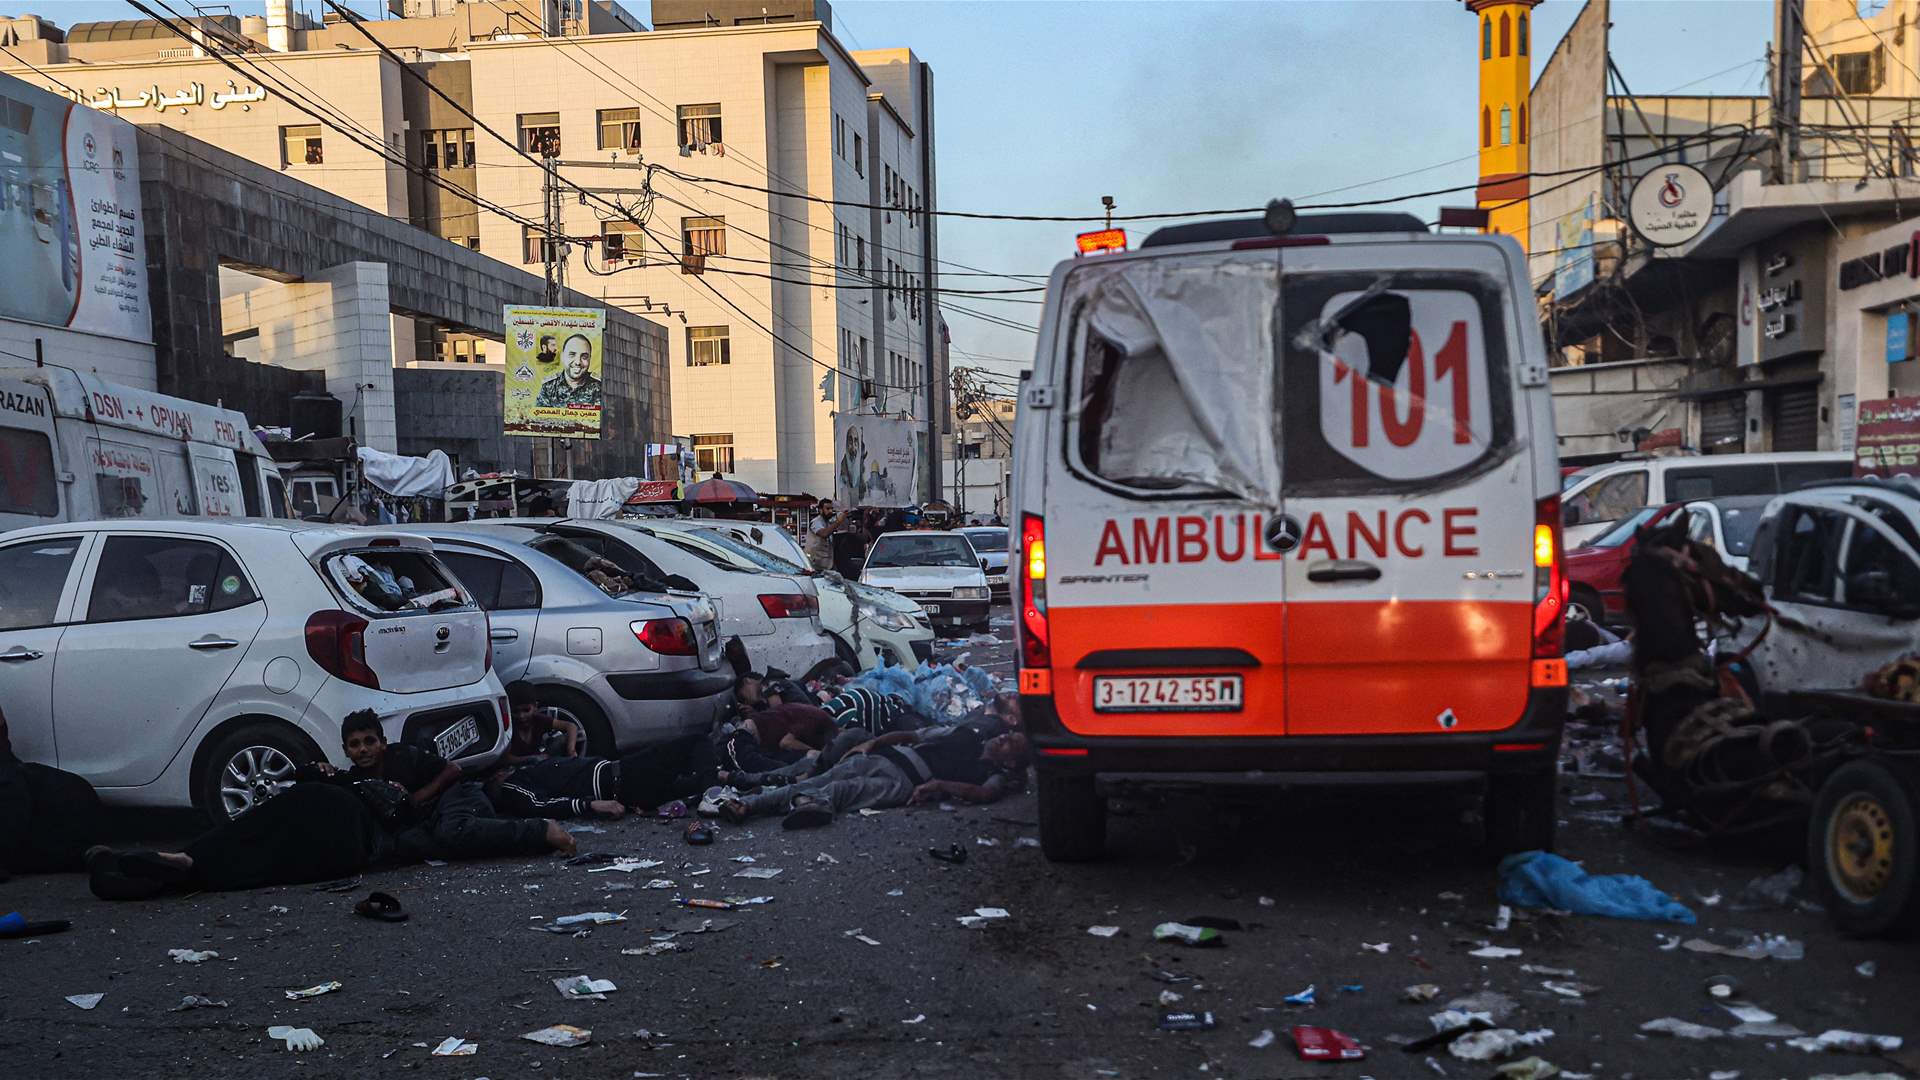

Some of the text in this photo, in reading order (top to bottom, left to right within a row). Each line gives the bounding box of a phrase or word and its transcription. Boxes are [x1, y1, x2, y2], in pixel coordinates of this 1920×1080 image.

[90, 81, 204, 114] الجراحات
[209, 80, 267, 111] مبنى
[83, 160, 100, 174] ICRC
[91, 199, 135, 221] قسم الطوارئ
[92, 218, 135, 239] الجديد لمجمع
[89, 233, 135, 255] الشفاء الطبي
[1334, 320, 1472, 448] 101
[0, 390, 45, 417] RAZAN
[92, 391, 125, 420] DSN
[214, 419, 236, 443] FHD
[1094, 507, 1479, 566] AMBULANCE
[1059, 573, 1149, 585] SPRINTER
